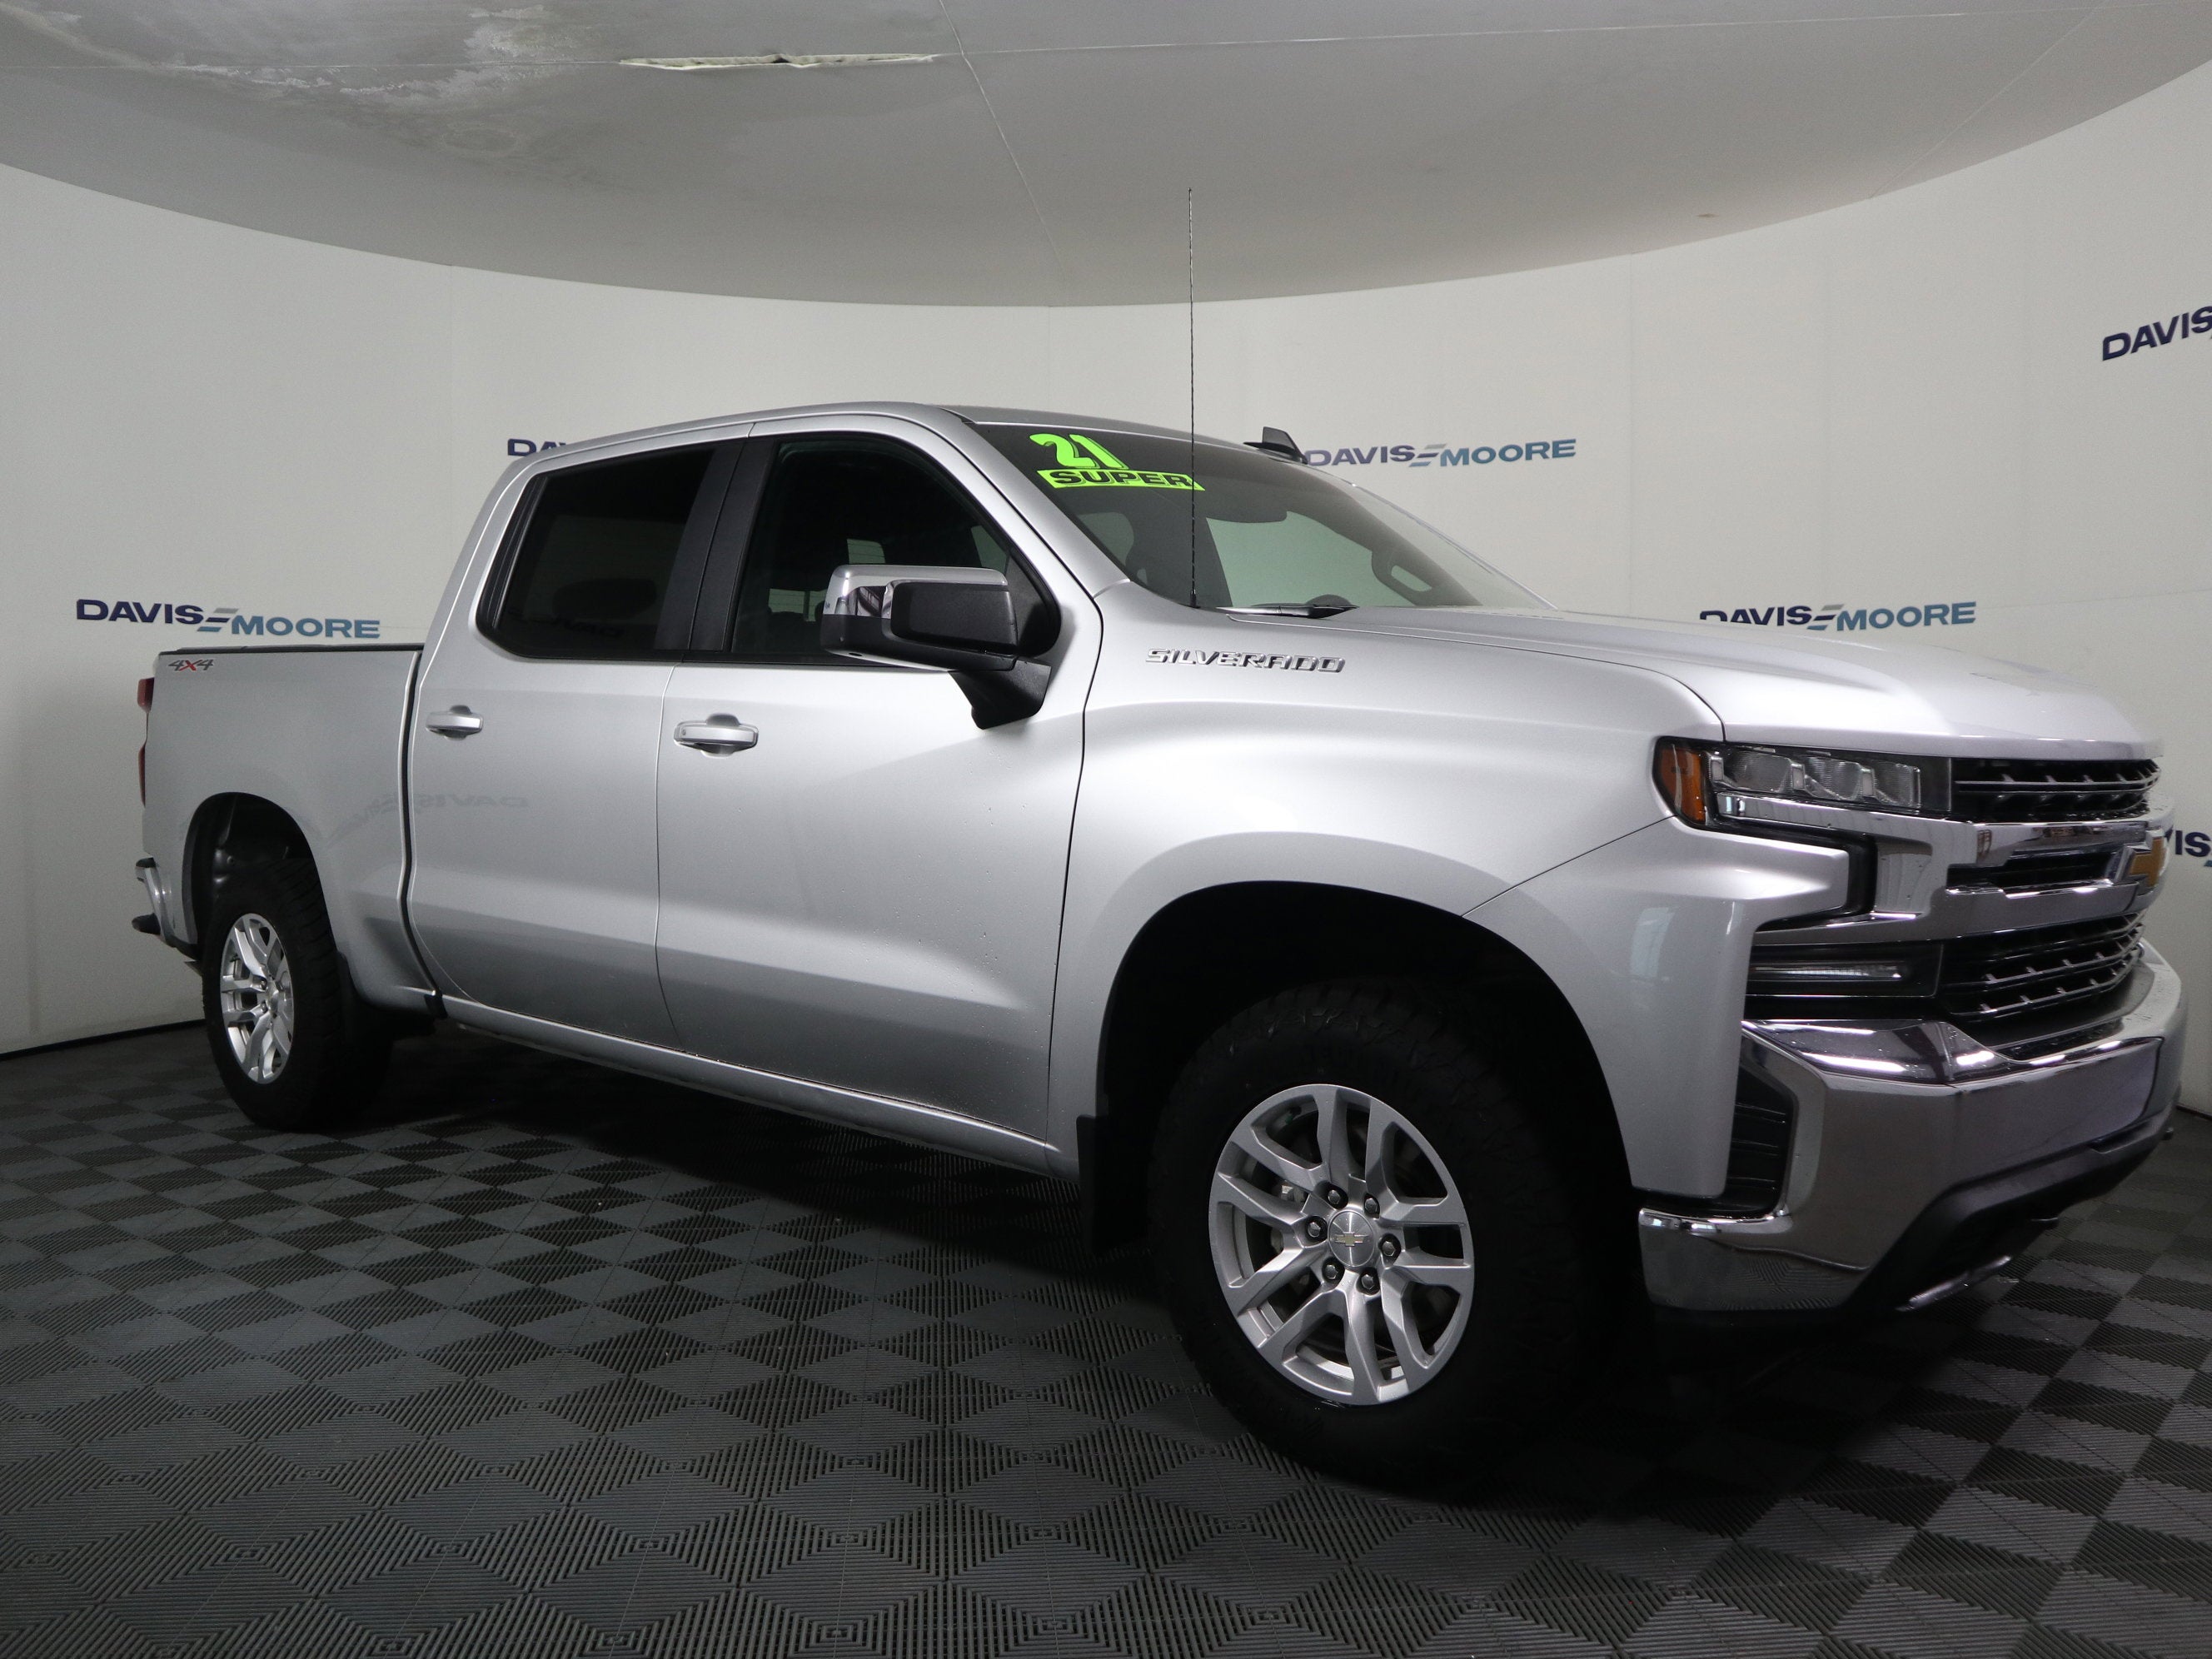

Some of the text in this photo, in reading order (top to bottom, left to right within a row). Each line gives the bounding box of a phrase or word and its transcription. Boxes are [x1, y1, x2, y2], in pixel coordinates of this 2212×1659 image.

[2103, 306, 2212, 361] DAVIS
[1029, 433, 1129, 470] 21
[1303, 438, 1577, 467] DAVIS MOORE
[1049, 471, 1194, 488] SUPER
[76, 599, 381, 639] DAVIS MOORE
[1836, 601, 1977, 631] MOORE
[1145, 648, 1346, 673] SILVERADO
